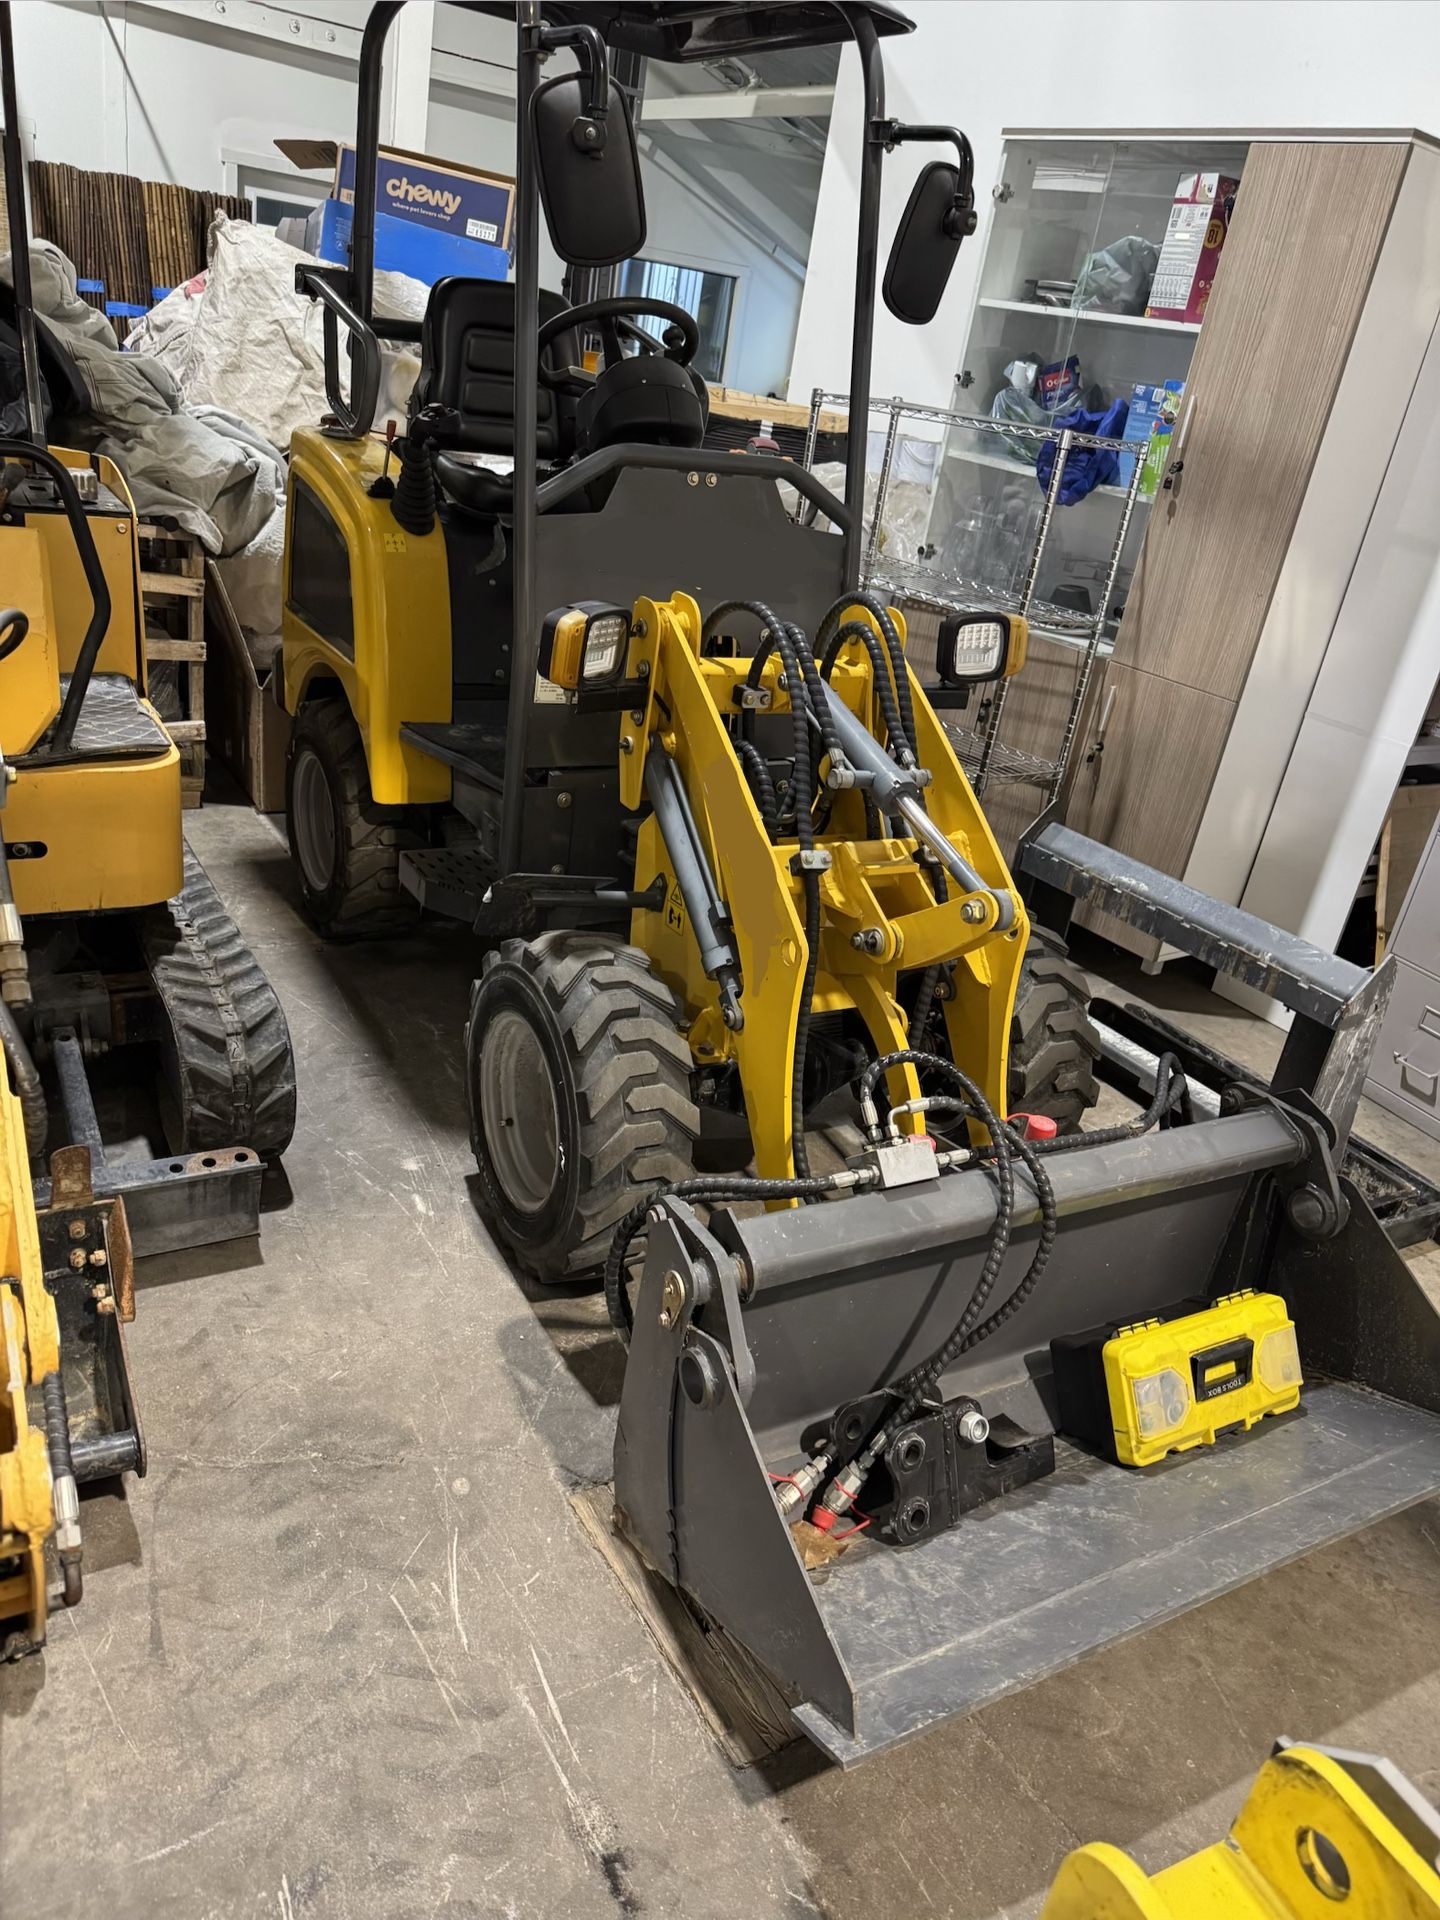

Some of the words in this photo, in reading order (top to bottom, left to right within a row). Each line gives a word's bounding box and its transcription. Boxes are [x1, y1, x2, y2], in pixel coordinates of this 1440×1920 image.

[386, 177, 462, 214] chewy
[1222, 1378, 1241, 1391] TOOLS
[1208, 1387, 1222, 1397] BOX
